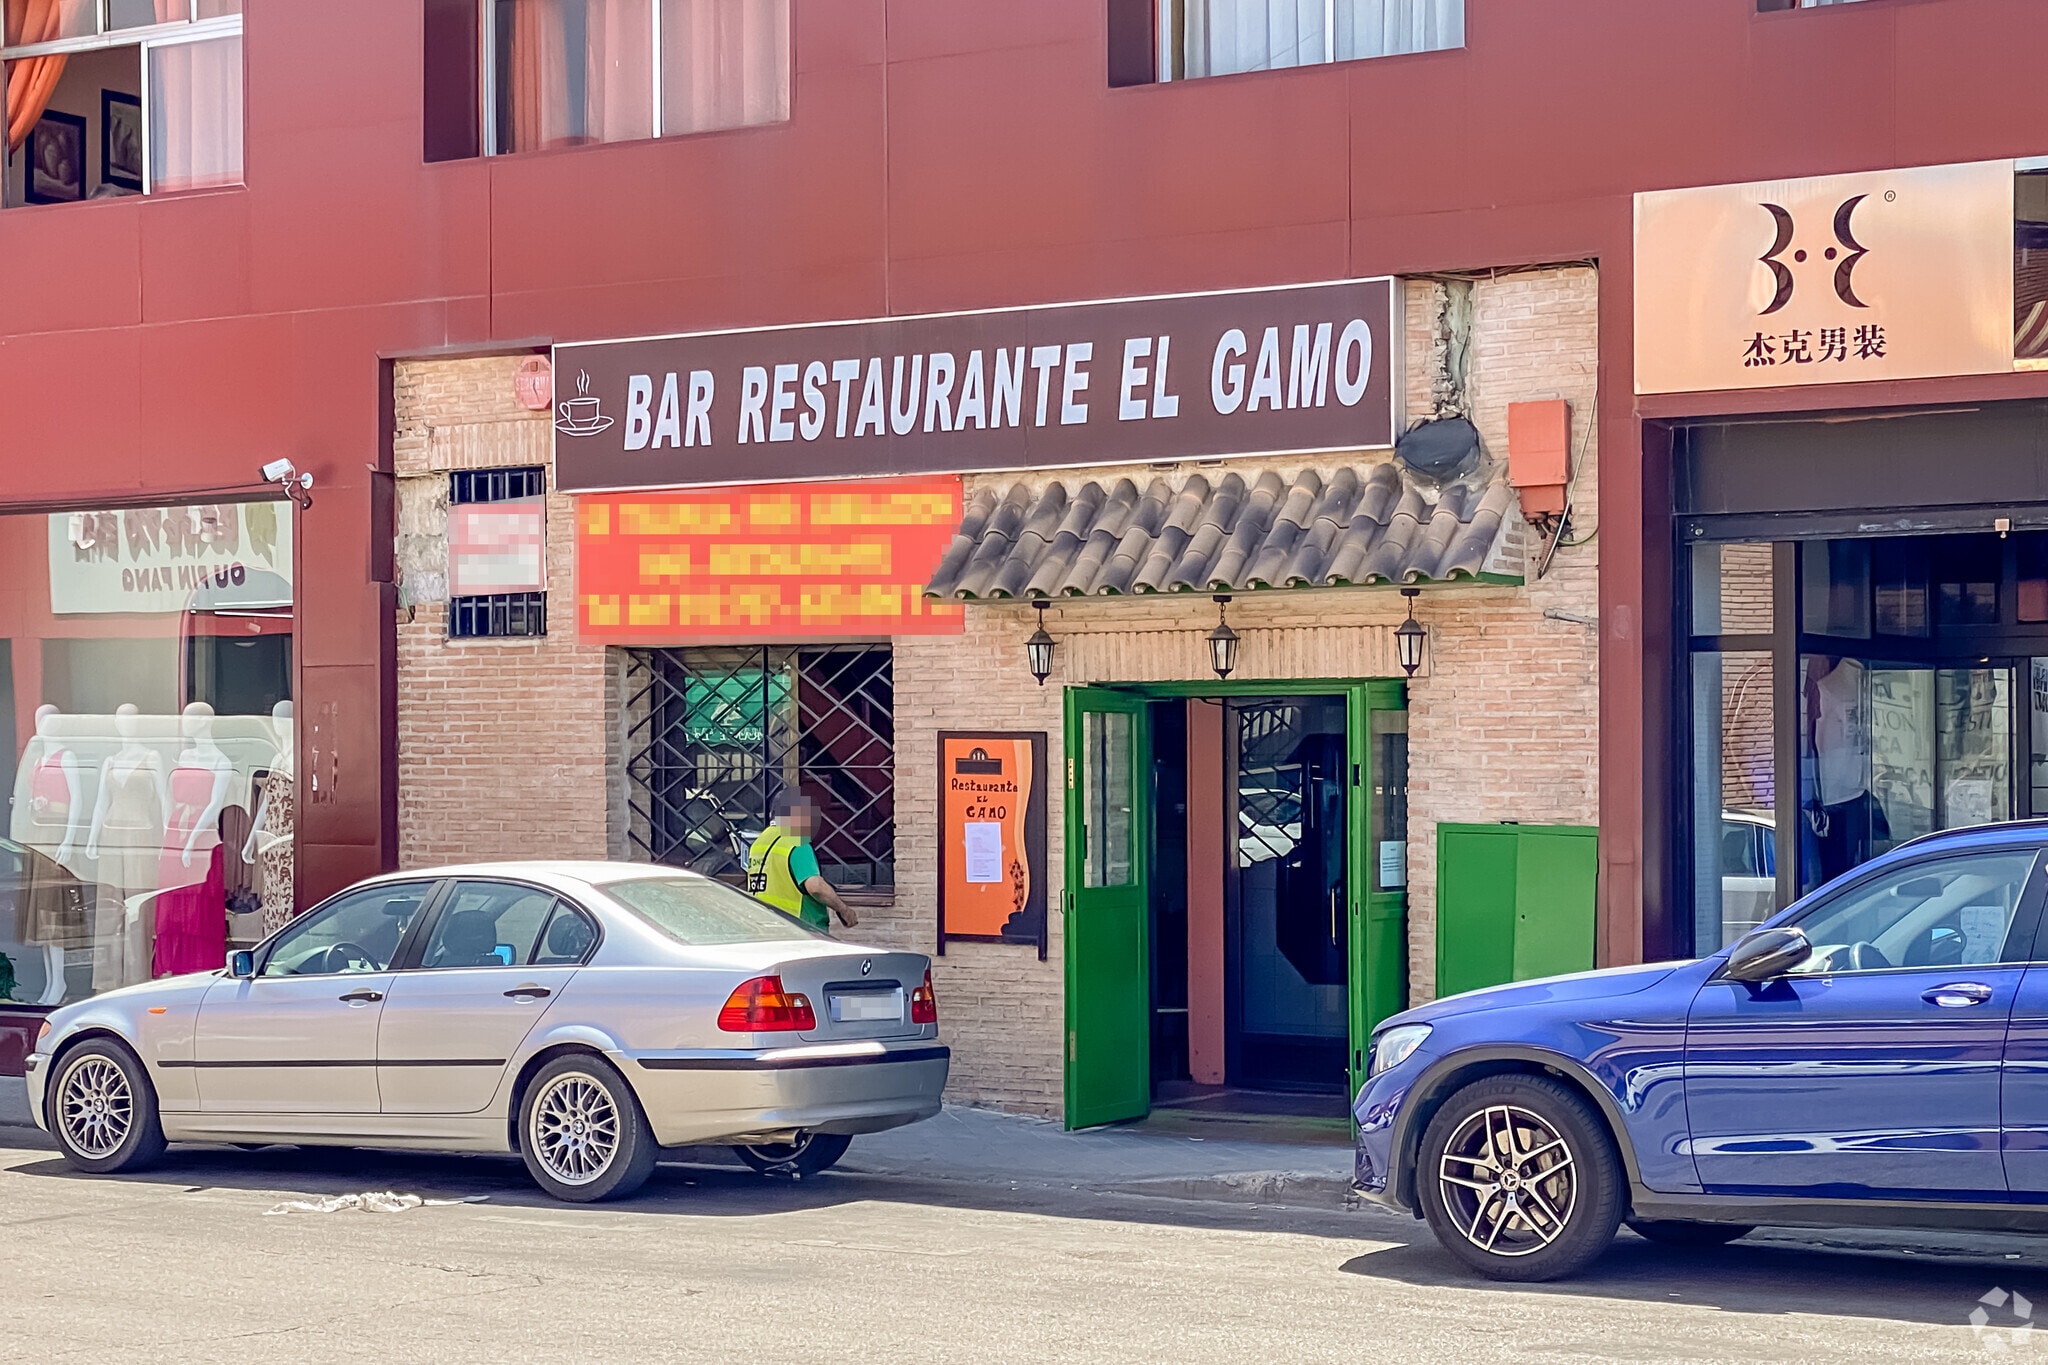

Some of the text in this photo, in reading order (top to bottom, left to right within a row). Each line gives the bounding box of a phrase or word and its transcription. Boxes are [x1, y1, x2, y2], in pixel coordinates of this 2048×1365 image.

[1741, 324, 1887, 368] 杰克男装
[623, 318, 1373, 451] BAR RESTAURANTE EL GAMO
[965, 805, 1007, 820] GAMO
